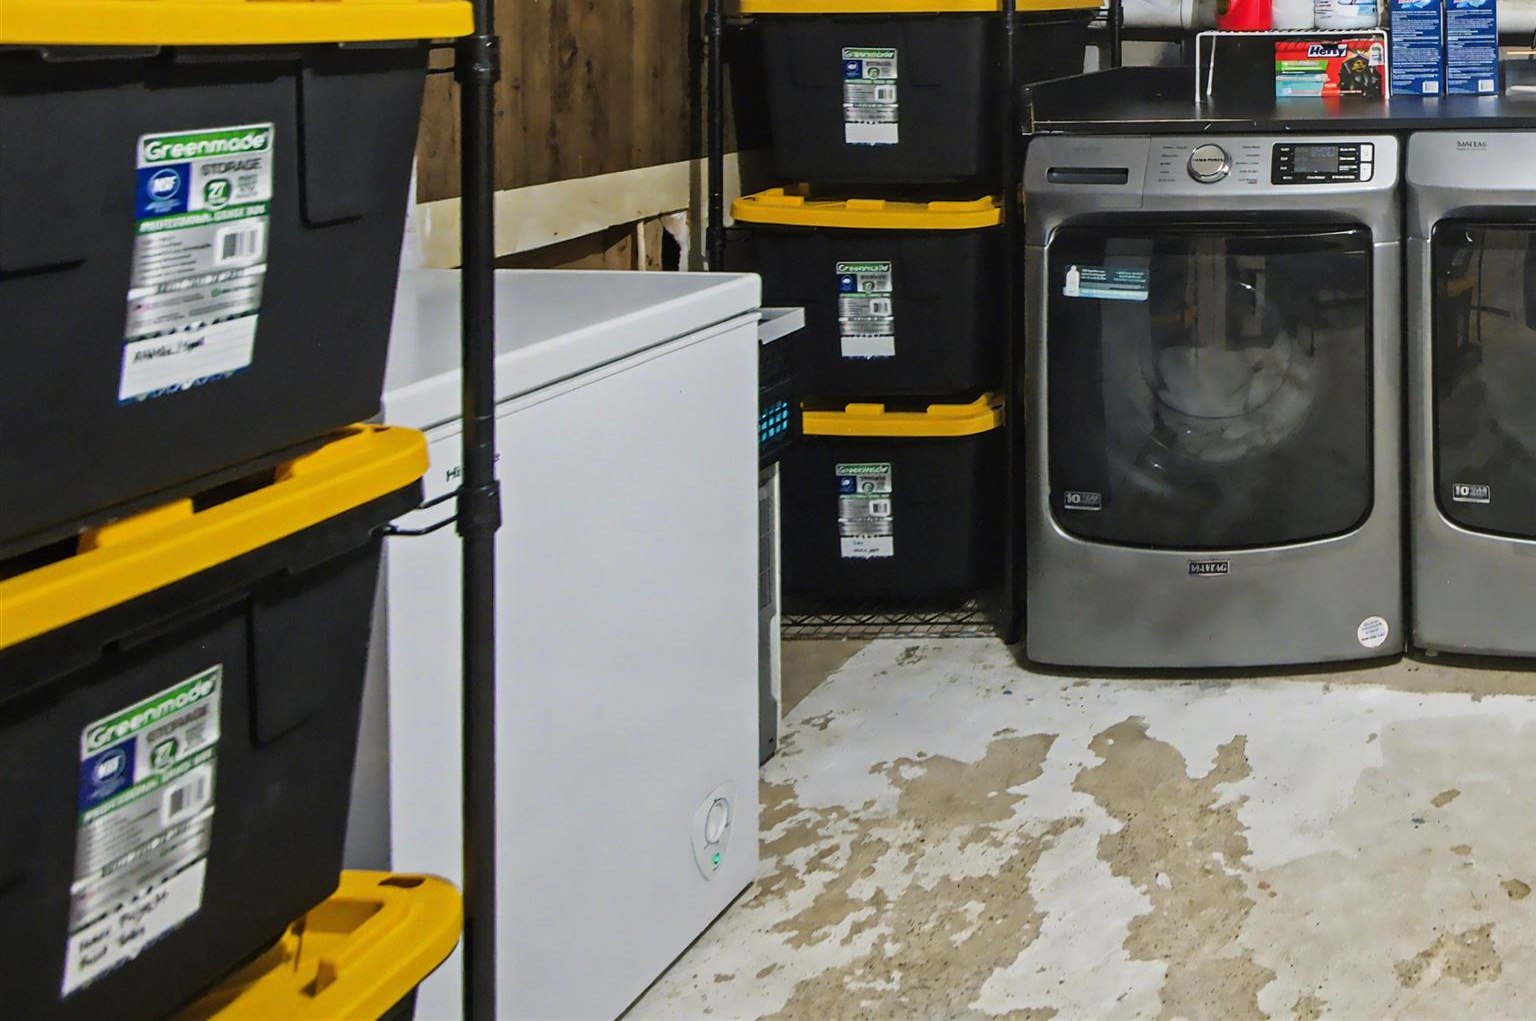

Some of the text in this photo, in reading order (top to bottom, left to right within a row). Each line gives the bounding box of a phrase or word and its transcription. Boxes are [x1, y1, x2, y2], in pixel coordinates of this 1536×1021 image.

[144, 132, 266, 161] Greenmade
[1455, 485, 1468, 496] 10
[1066, 492, 1081, 504] 10
[1189, 561, 1228, 574] MAYTAG
